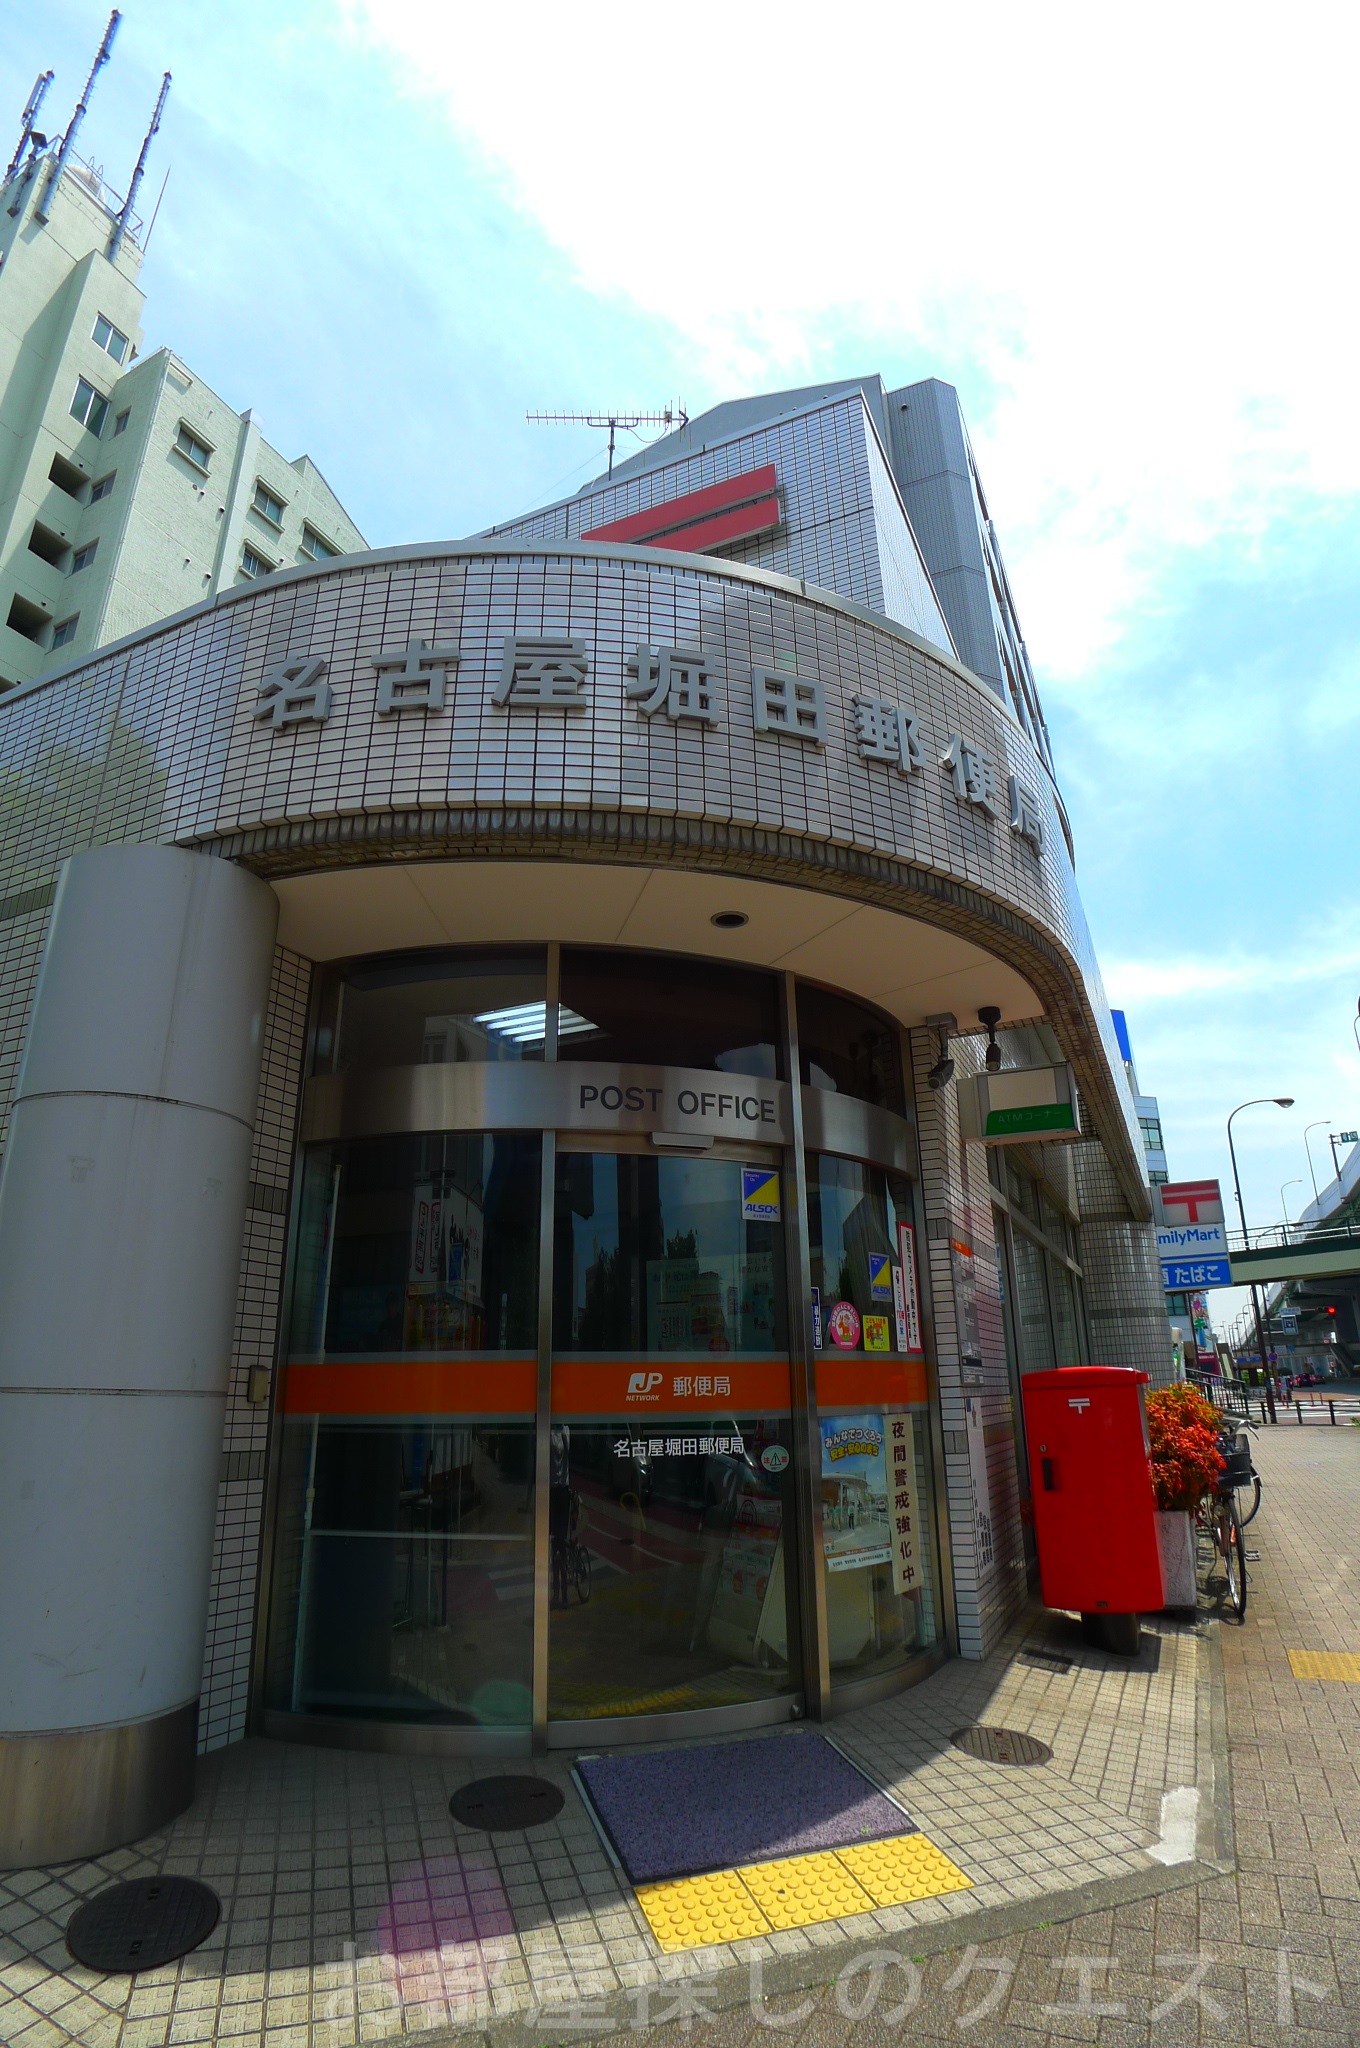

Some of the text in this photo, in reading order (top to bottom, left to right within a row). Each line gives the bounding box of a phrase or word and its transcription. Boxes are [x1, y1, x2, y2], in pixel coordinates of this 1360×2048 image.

[250, 635, 1043, 857] 名古屋堀田郵便局
[579, 1084, 777, 1124] POST OFFICE
[997, 1109, 1063, 1124] ATMコーナー
[745, 1203, 778, 1214] ALSOK
[1175, 1265, 1221, 1284] たばこ
[872, 1285, 891, 1296] ALSOK
[627, 1372, 664, 1393] JP
[672, 1375, 731, 1398] 郵便局
[625, 1394, 660, 1402] NETWORK
[613, 1436, 745, 1459] 名古屋堀田郵便局
[824, 1427, 883, 1448] みんなでつくろう
[891, 1421, 916, 1584] 夜間警戒強化中
